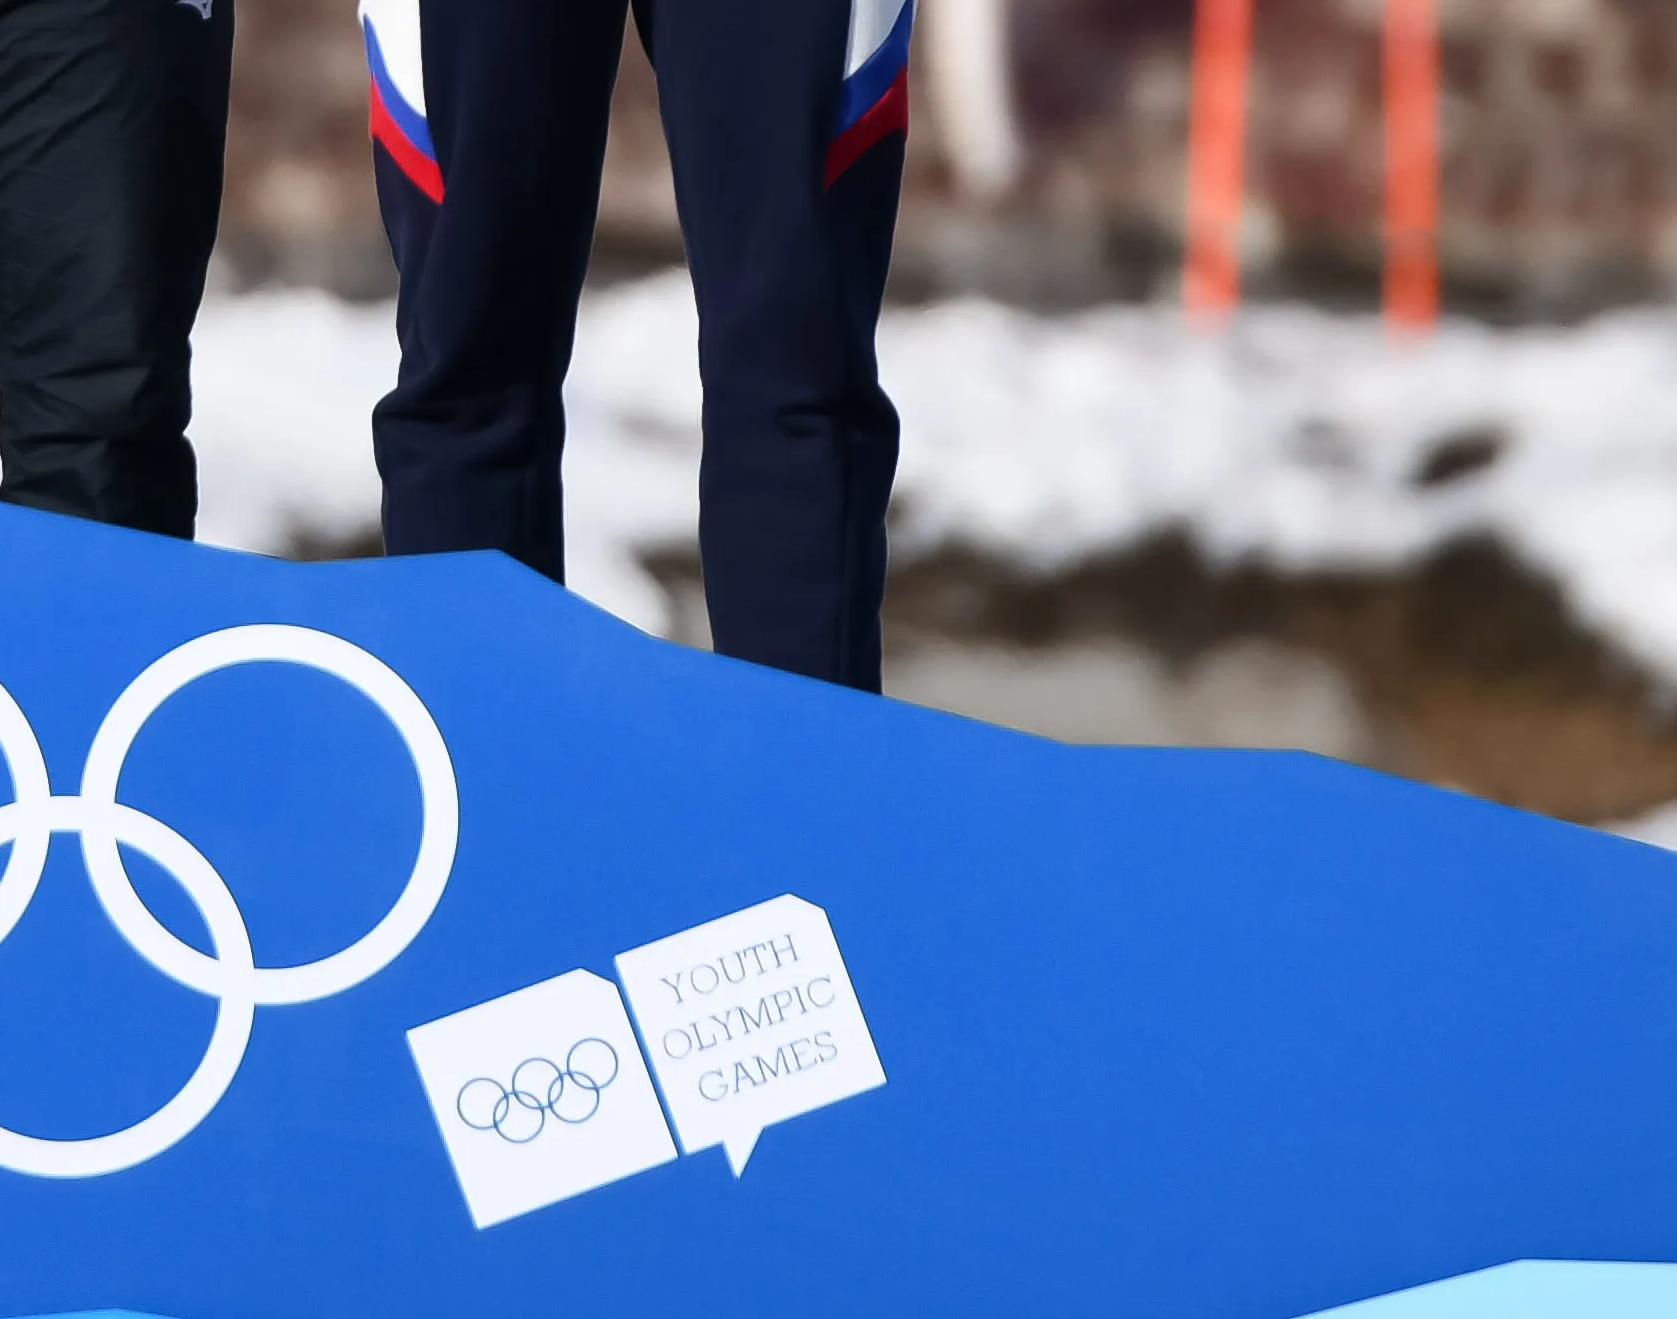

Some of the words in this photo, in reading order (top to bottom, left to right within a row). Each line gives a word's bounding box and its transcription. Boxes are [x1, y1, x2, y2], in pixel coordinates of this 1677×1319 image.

[659, 932, 800, 1005] YOUTH
[662, 974, 836, 1060] OLYMPIC
[698, 1030, 838, 1102] GAMES
